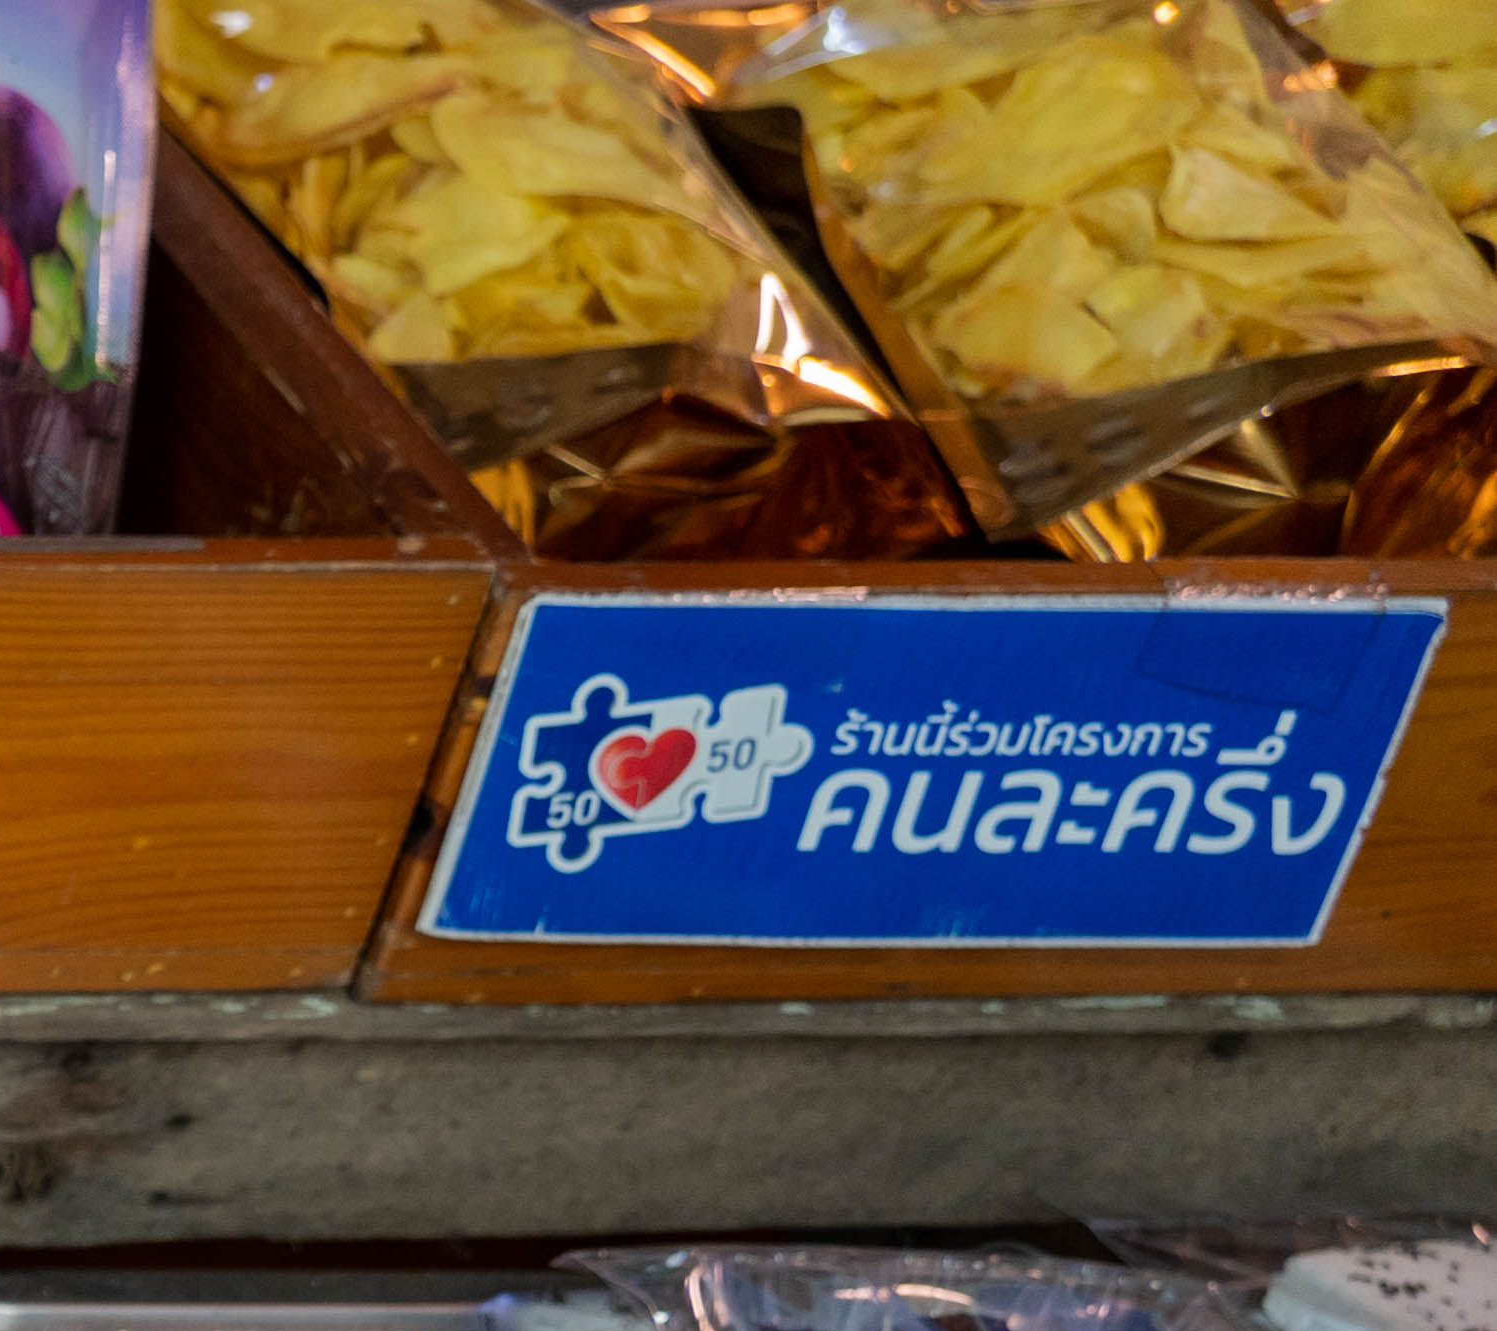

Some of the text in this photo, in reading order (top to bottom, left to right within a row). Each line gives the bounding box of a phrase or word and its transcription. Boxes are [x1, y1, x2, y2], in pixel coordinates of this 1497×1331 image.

[706, 738, 758, 773] 50
[831, 702, 1212, 760] ร้านนี้ร่วมโครงการ
[797, 712, 1347, 857] คนละครึ่ง
[548, 791, 601, 831] 50
